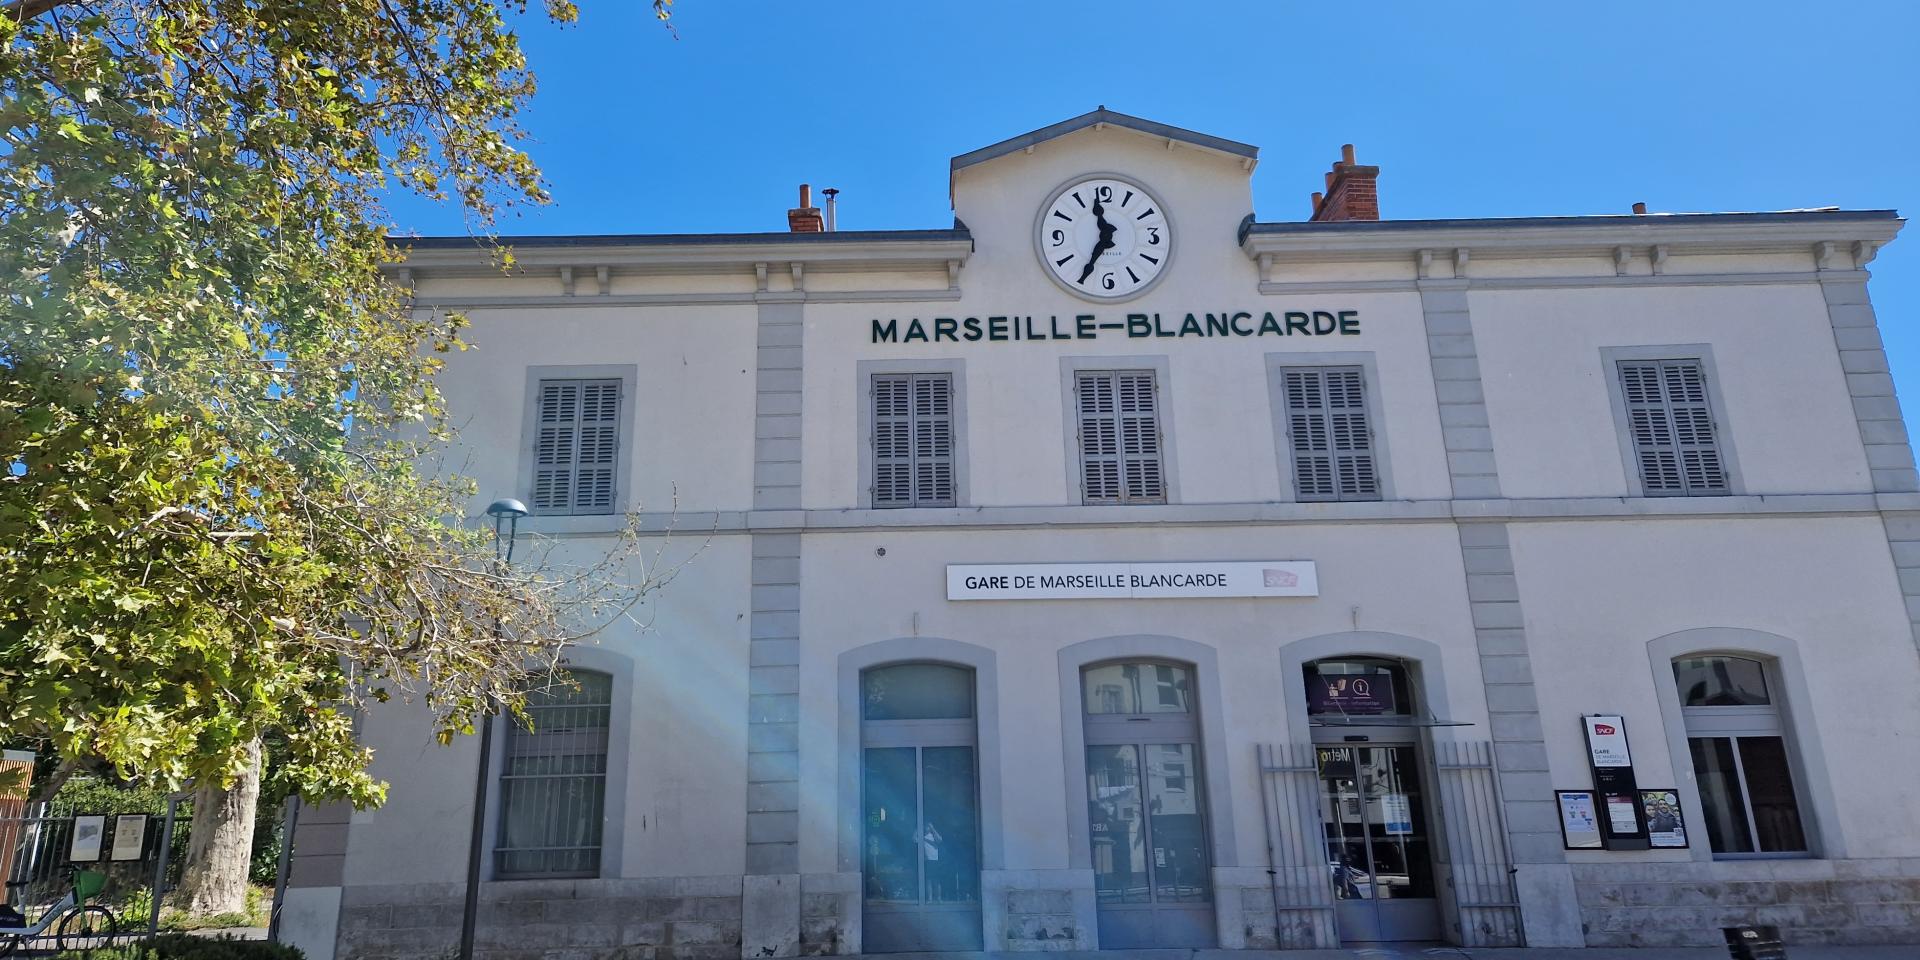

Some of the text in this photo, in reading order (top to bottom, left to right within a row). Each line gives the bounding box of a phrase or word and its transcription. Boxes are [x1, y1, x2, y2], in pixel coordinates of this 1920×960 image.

[1052, 229, 1065, 247] 9
[1147, 227, 1160, 245] 3
[1102, 272, 1115, 290] 6
[965, 574, 1227, 589] GARE DE MARSEILLE BLANCARDE
